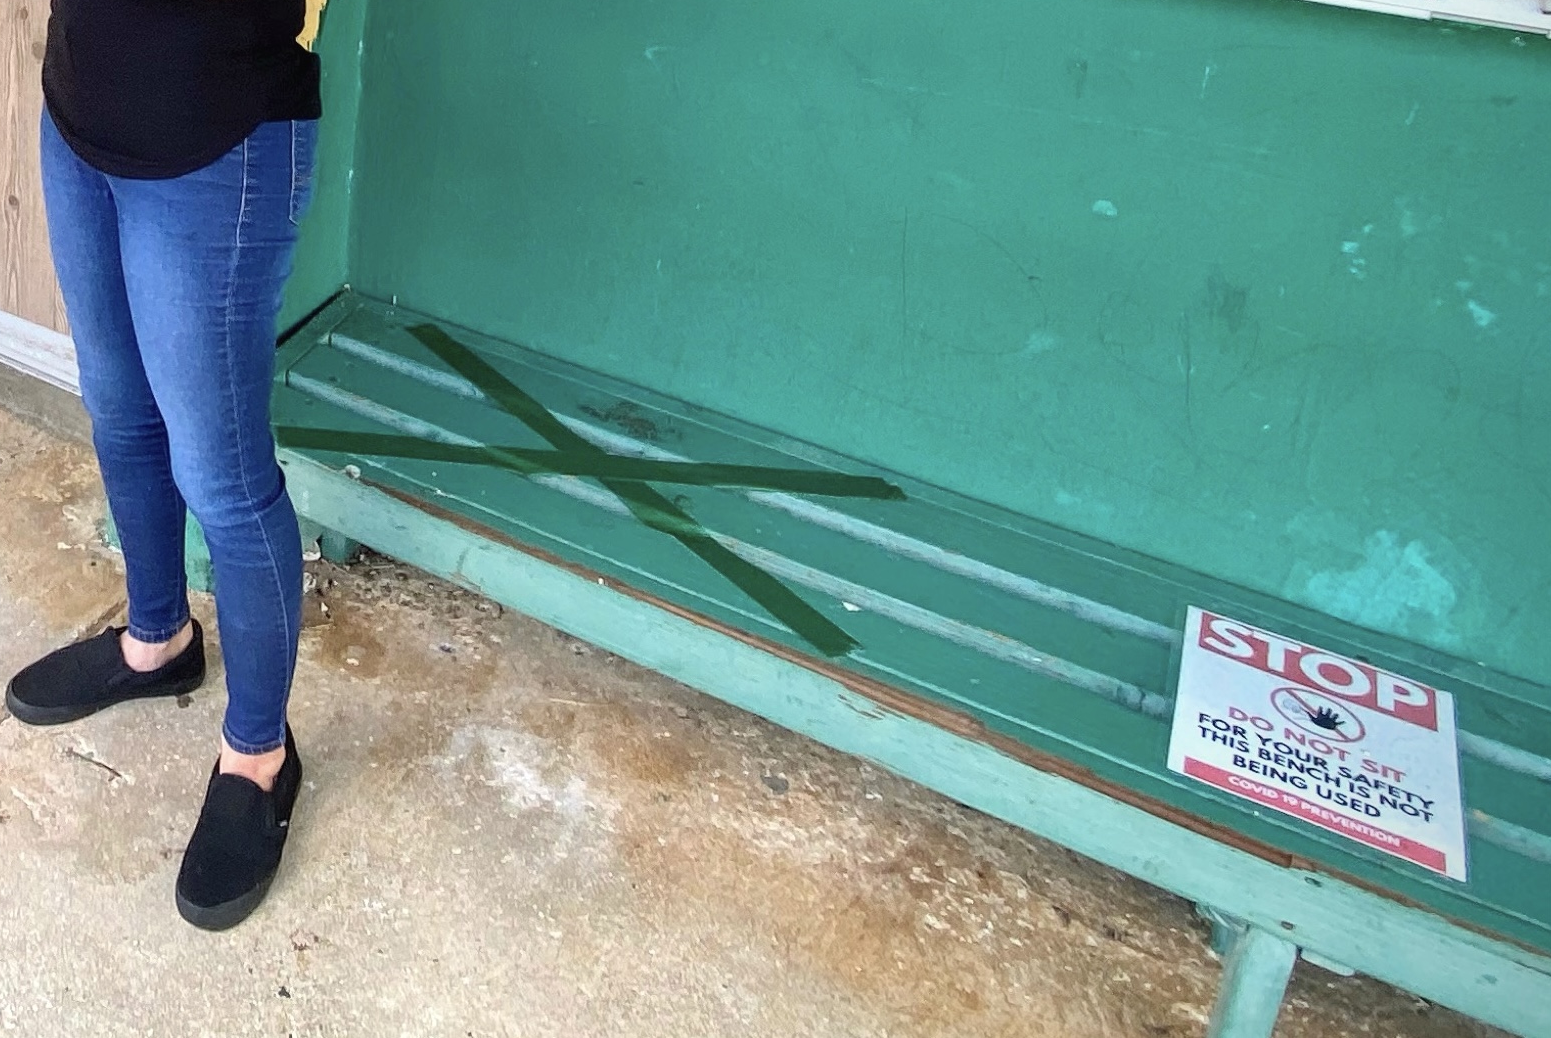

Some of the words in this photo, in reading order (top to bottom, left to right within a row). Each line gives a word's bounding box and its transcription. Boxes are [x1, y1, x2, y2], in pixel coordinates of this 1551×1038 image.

[1203, 618, 1429, 712] STOP
[1198, 725, 1250, 753] THIS
[1258, 748, 1340, 788] BENCH
[1349, 782, 1370, 799] IS
[1379, 794, 1434, 823] NOT
[1199, 712, 1248, 741] FOR
[1256, 732, 1328, 771] YOUR
[1338, 766, 1434, 809] SAFETY
[1229, 706, 1274, 732] DO
[1284, 727, 1350, 762] NOT
[1360, 757, 1407, 783] SIT
[1232, 753, 1308, 790] BEING
[1316, 785, 1381, 818] USED
[1228, 775, 1279, 800] COVID
[1282, 794, 1297, 807] 19
[1301, 798, 1400, 846] PREVENTION
